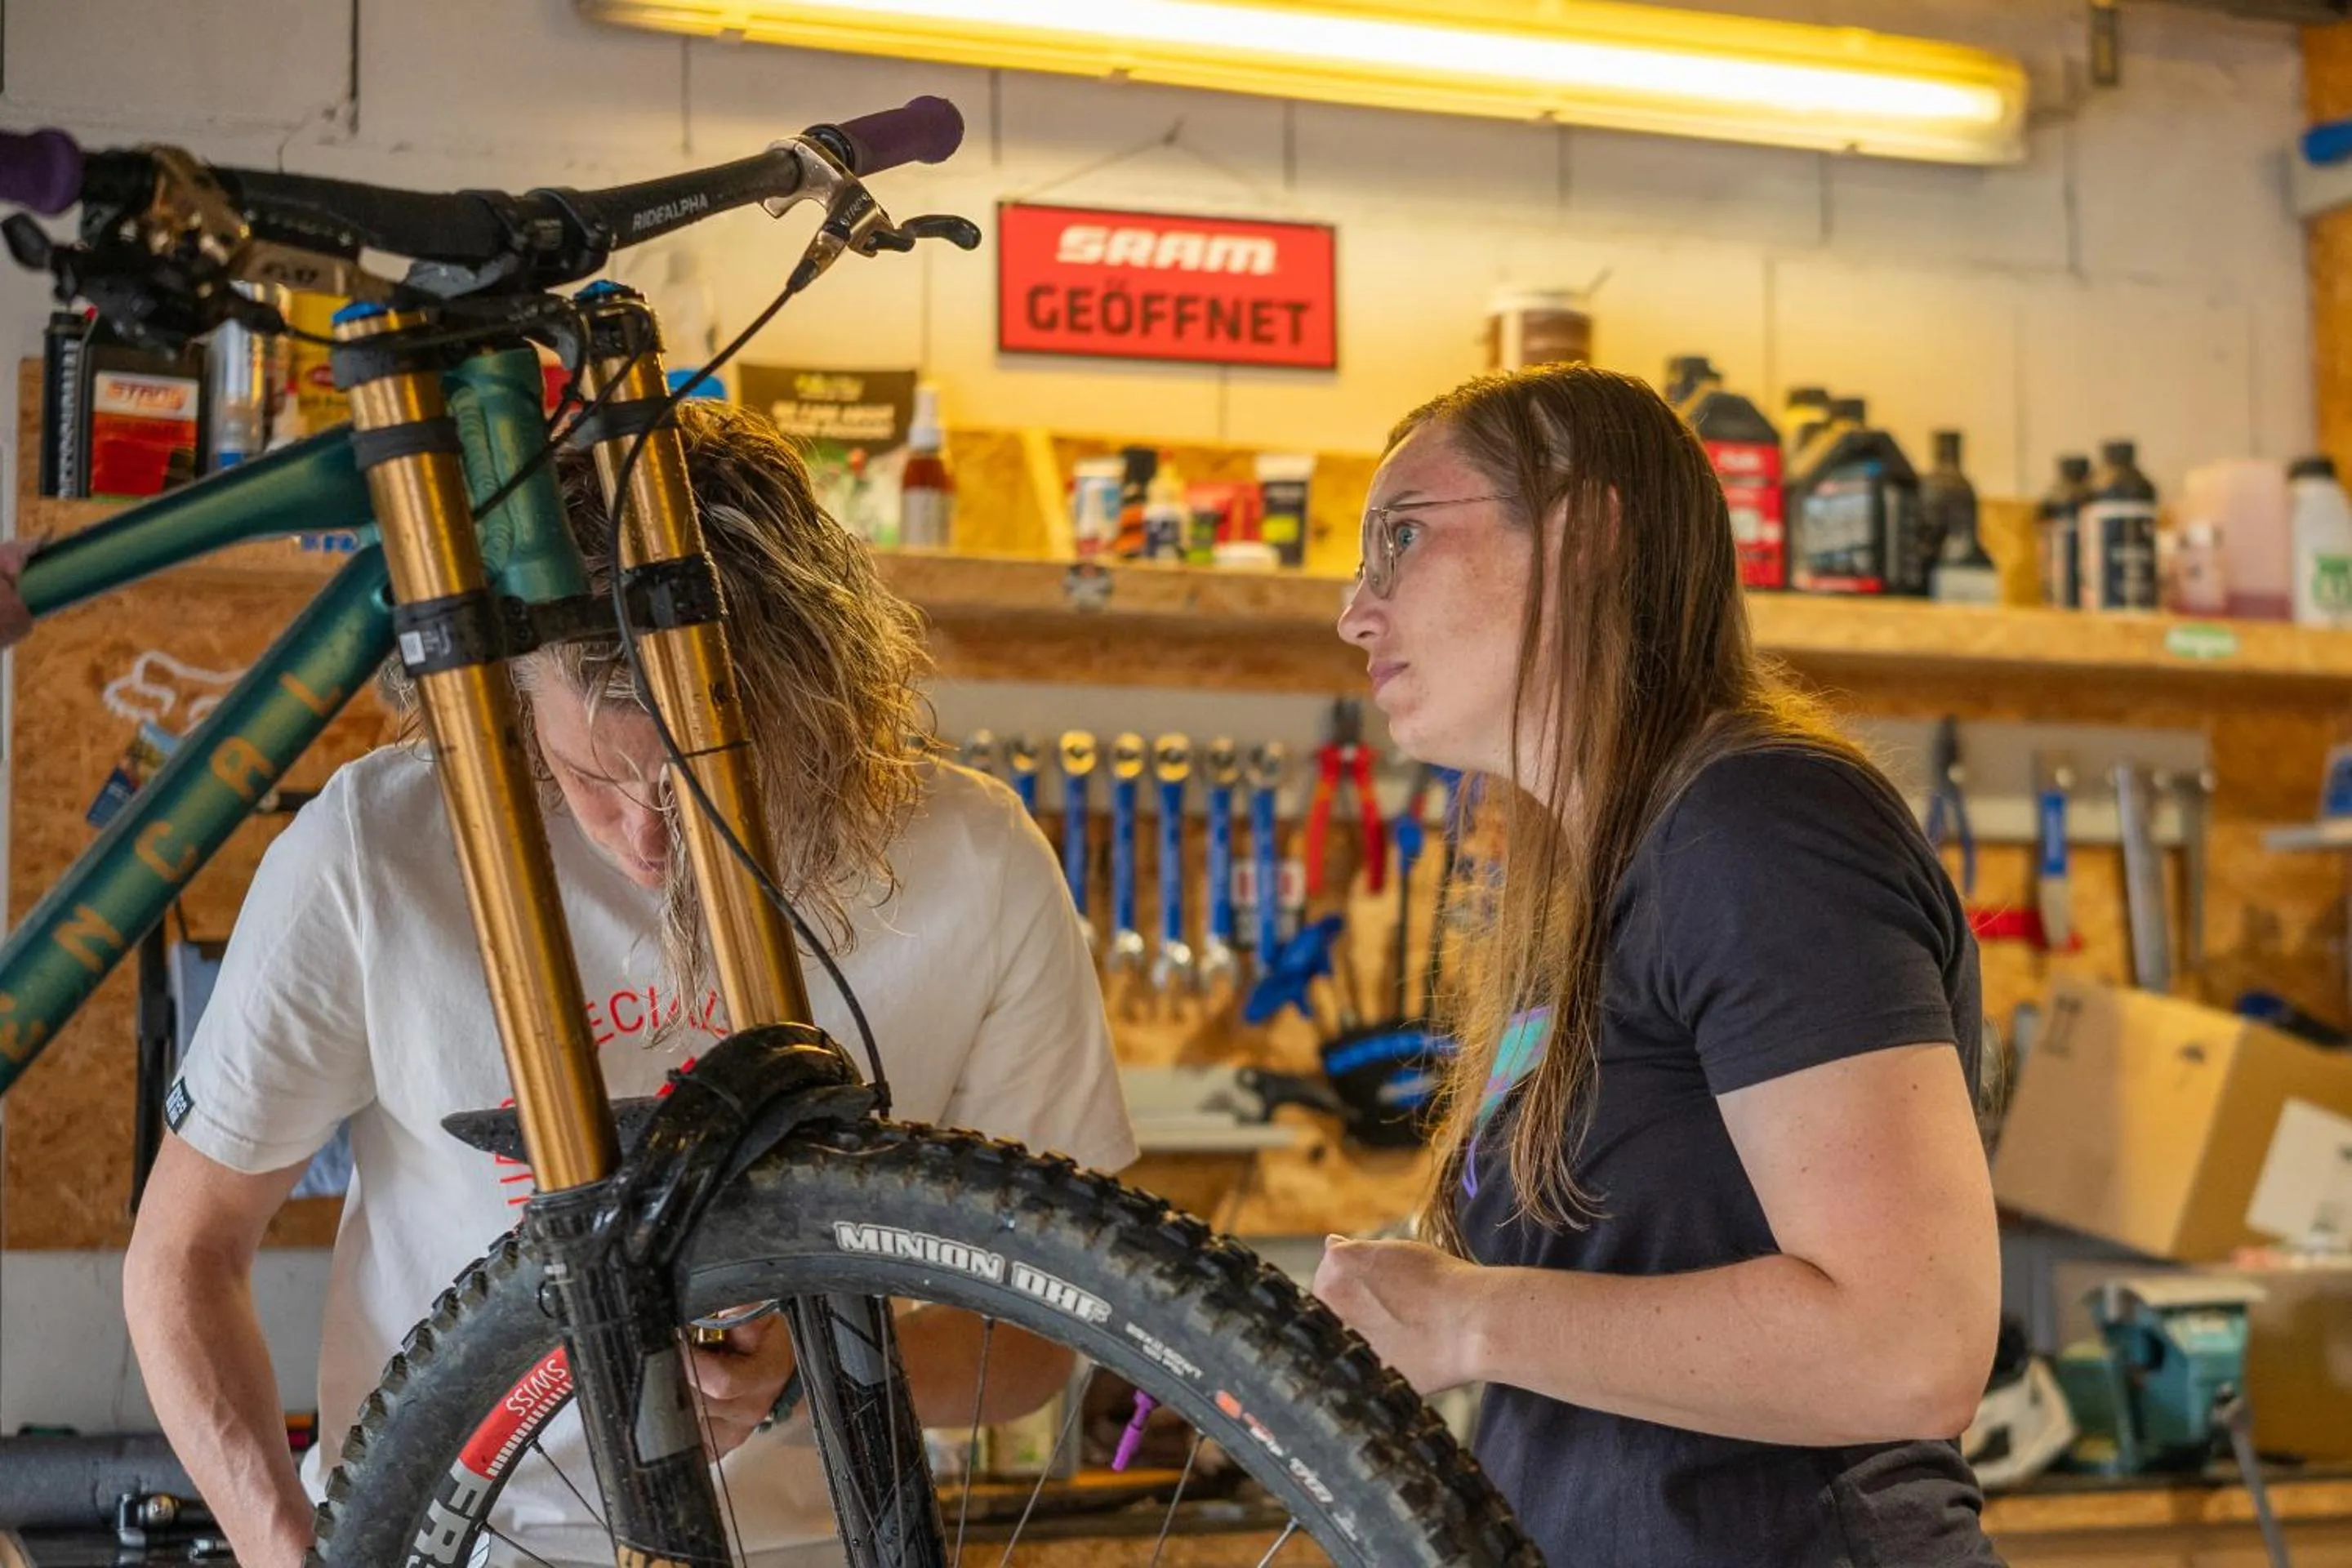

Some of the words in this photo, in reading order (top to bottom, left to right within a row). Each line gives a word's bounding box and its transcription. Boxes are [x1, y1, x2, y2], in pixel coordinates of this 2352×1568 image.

[632, 192, 709, 232] RIDEALPHA
[1056, 224, 1276, 276] SRAM
[1027, 278, 1311, 347] GEÖFFNET
[834, 1221, 1005, 1284] MINION
[506, 1358, 567, 1417] SWISS
